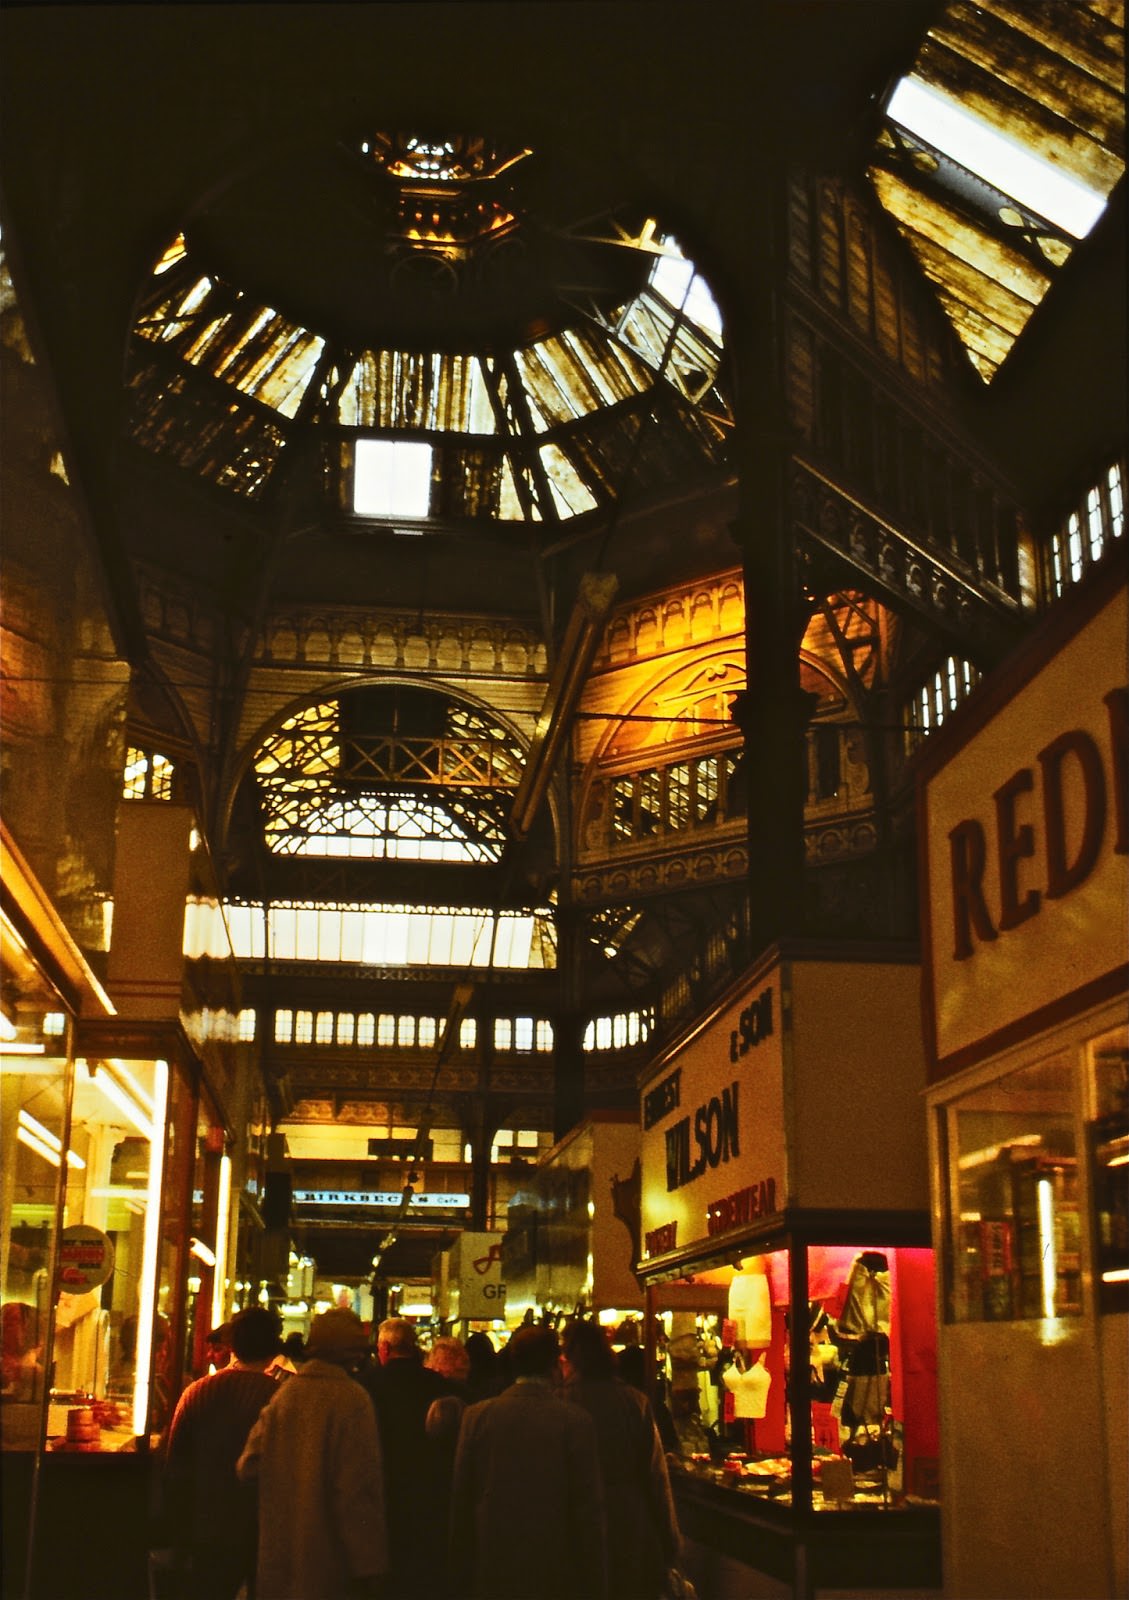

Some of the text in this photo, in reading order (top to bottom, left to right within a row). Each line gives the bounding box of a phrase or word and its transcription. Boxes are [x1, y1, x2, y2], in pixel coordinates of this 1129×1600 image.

[739, 986, 773, 1056] SON
[665, 1081, 740, 1192] WILSON
[304, 1193, 428, 1204] BIRKBECS
